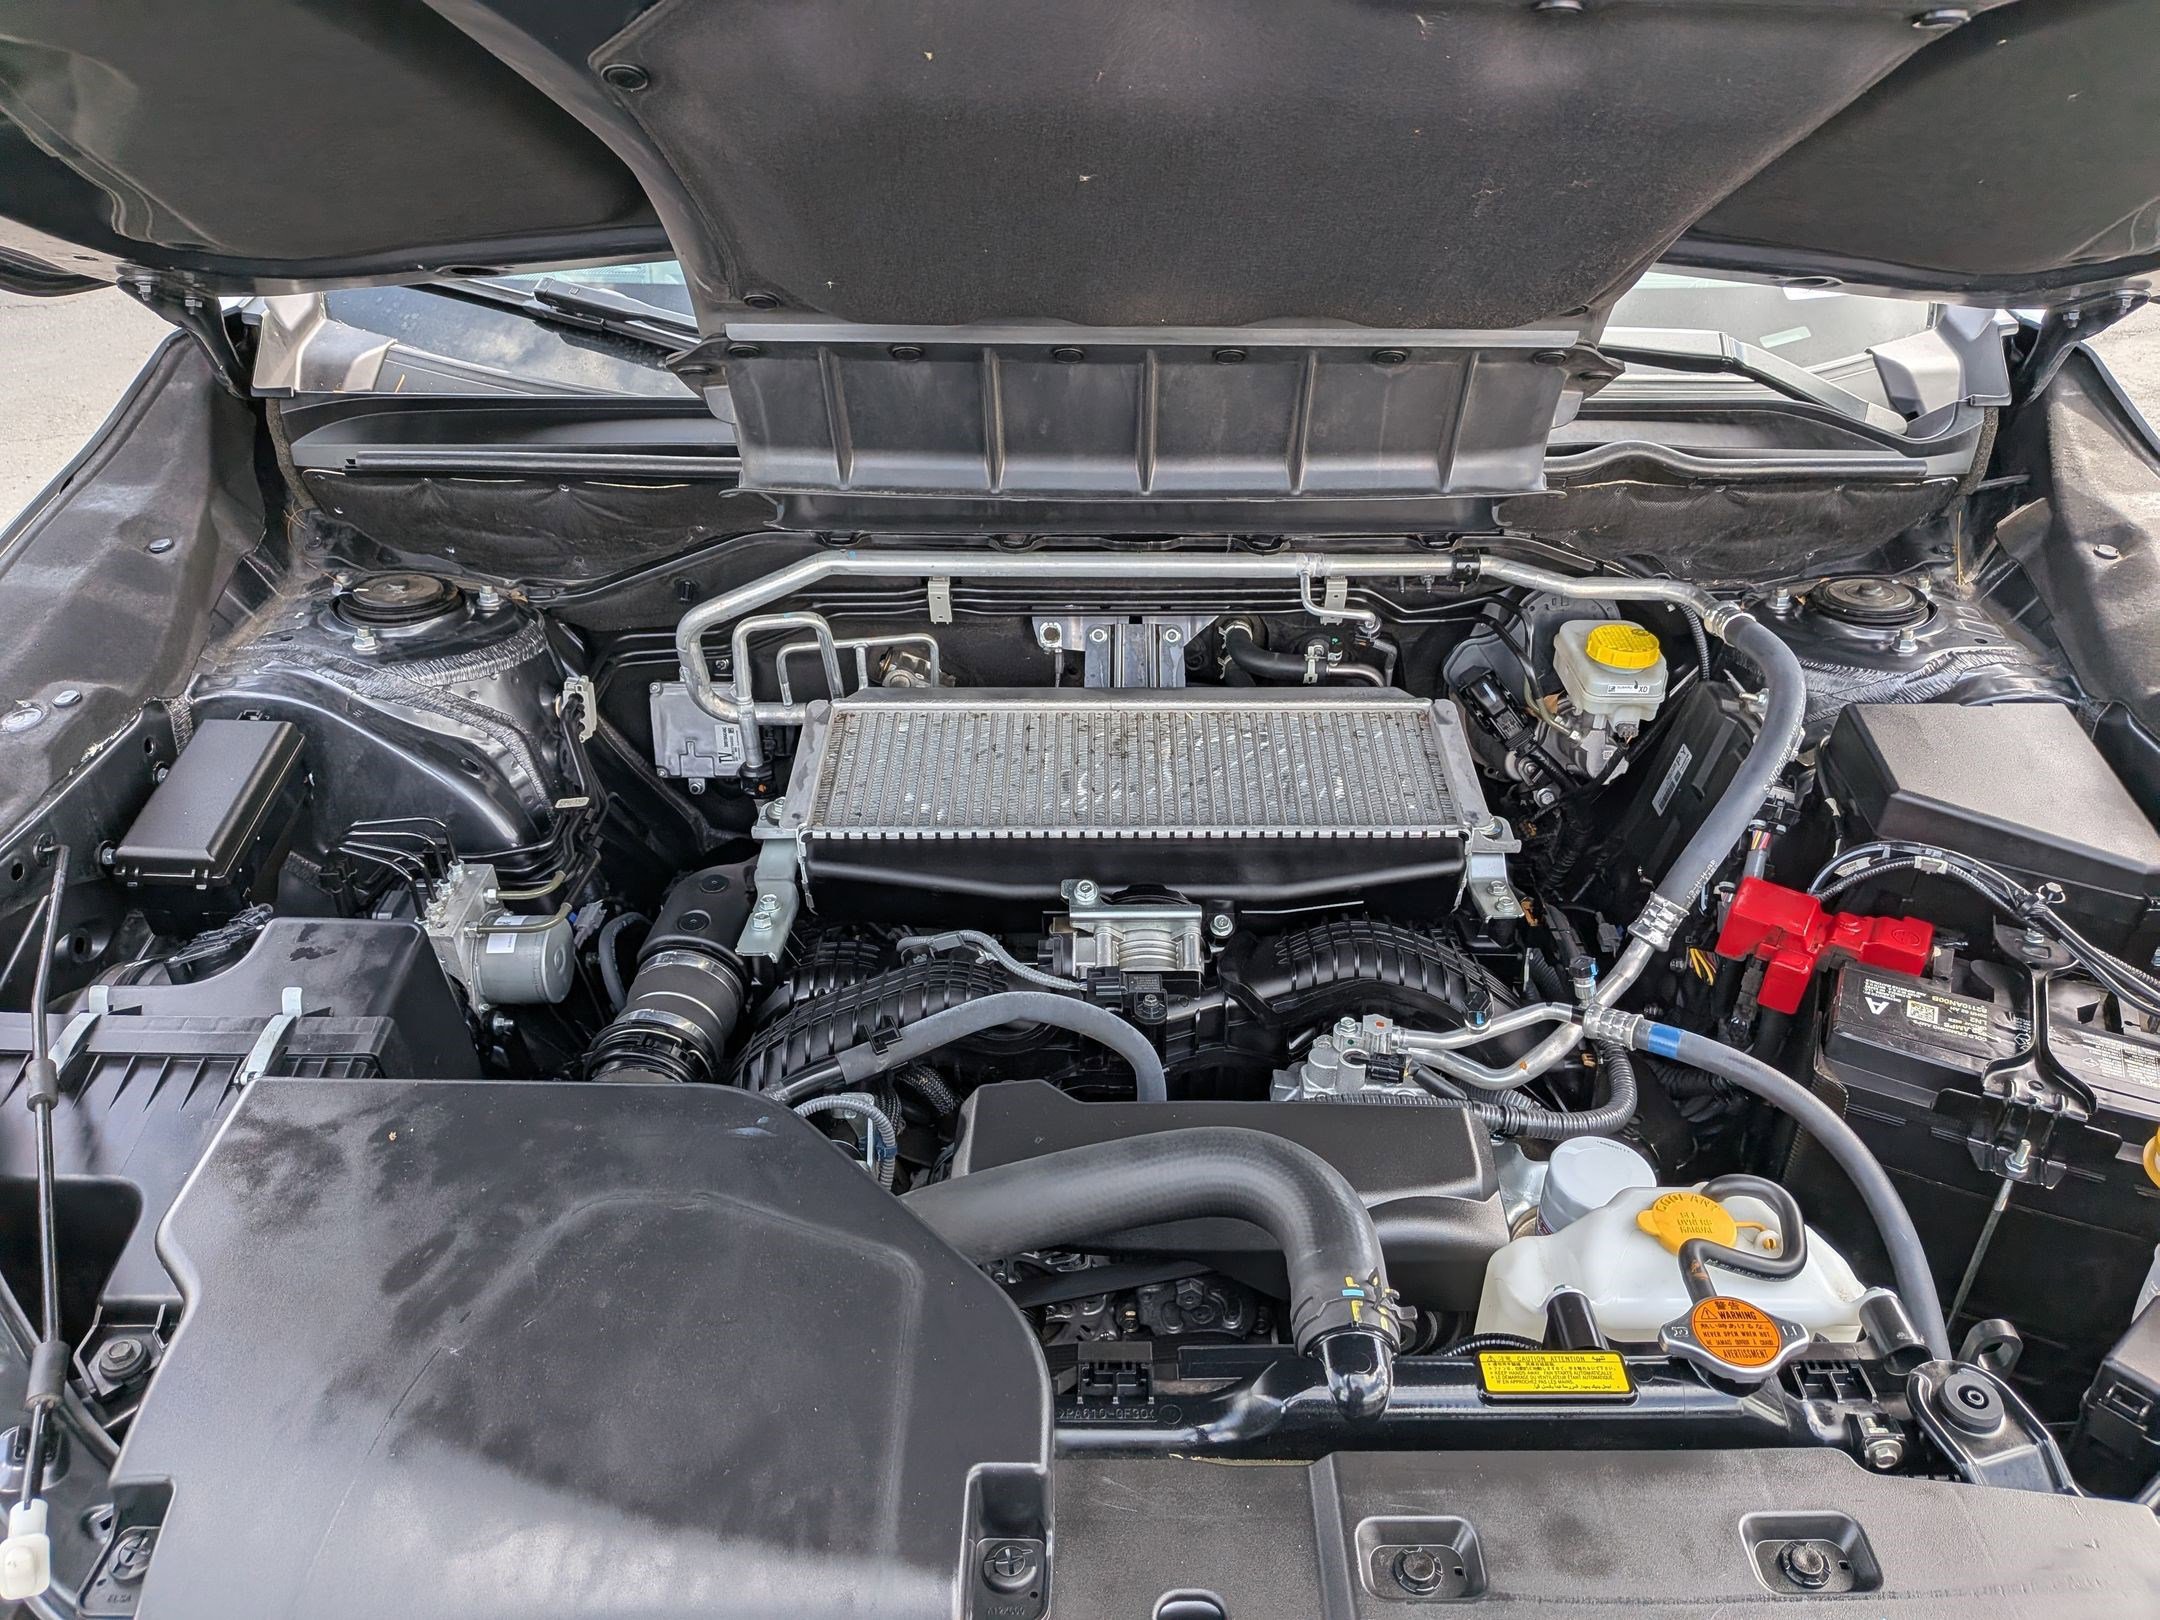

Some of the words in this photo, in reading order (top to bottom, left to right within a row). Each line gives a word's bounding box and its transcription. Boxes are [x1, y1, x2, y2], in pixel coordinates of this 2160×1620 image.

[1931, 996, 1988, 1014] 82110AN00B
[1969, 1016, 1988, 1026] LN2
[1968, 1033, 1988, 1042] COLD
[1717, 1311, 1758, 1320] WARNING
[1703, 1330, 1721, 1338] NEVER
[1516, 1355, 1546, 1363] CAUTION
[1550, 1355, 1586, 1363] ATTENTION
